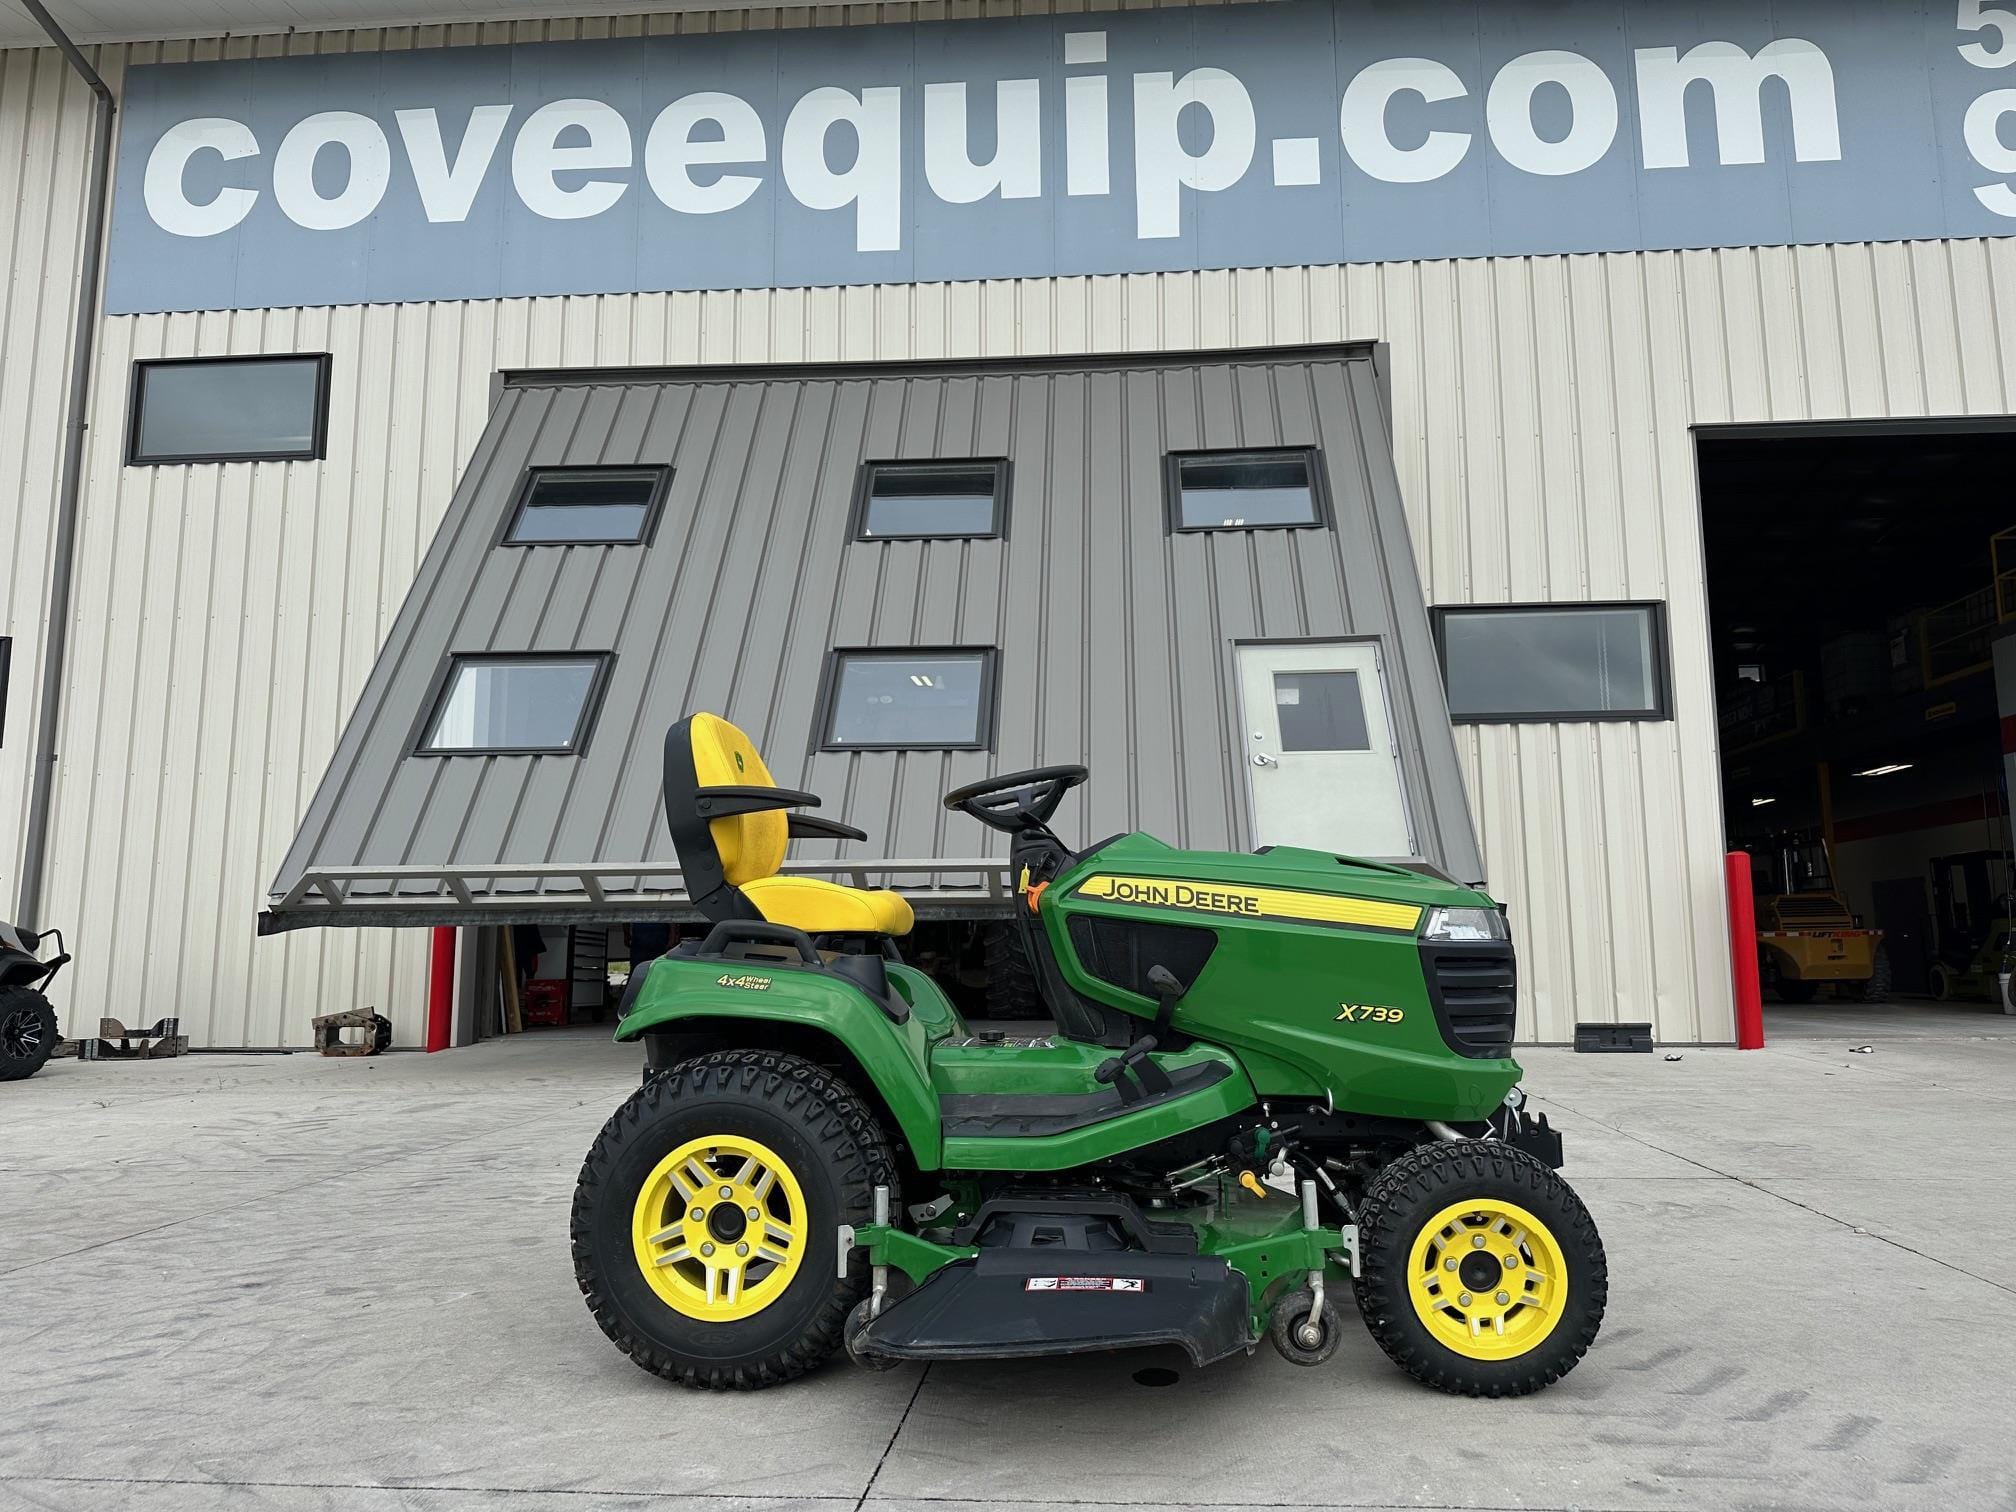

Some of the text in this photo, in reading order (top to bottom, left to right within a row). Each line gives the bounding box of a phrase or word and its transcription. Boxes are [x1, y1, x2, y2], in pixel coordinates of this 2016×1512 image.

[143, 31, 1843, 252] coveequip.com
[1102, 878, 1260, 914] JOHN DEERE
[717, 974, 772, 988] 4x4 Wheel
[743, 982, 769, 991] Steer
[1335, 1003, 1405, 1024] X739
